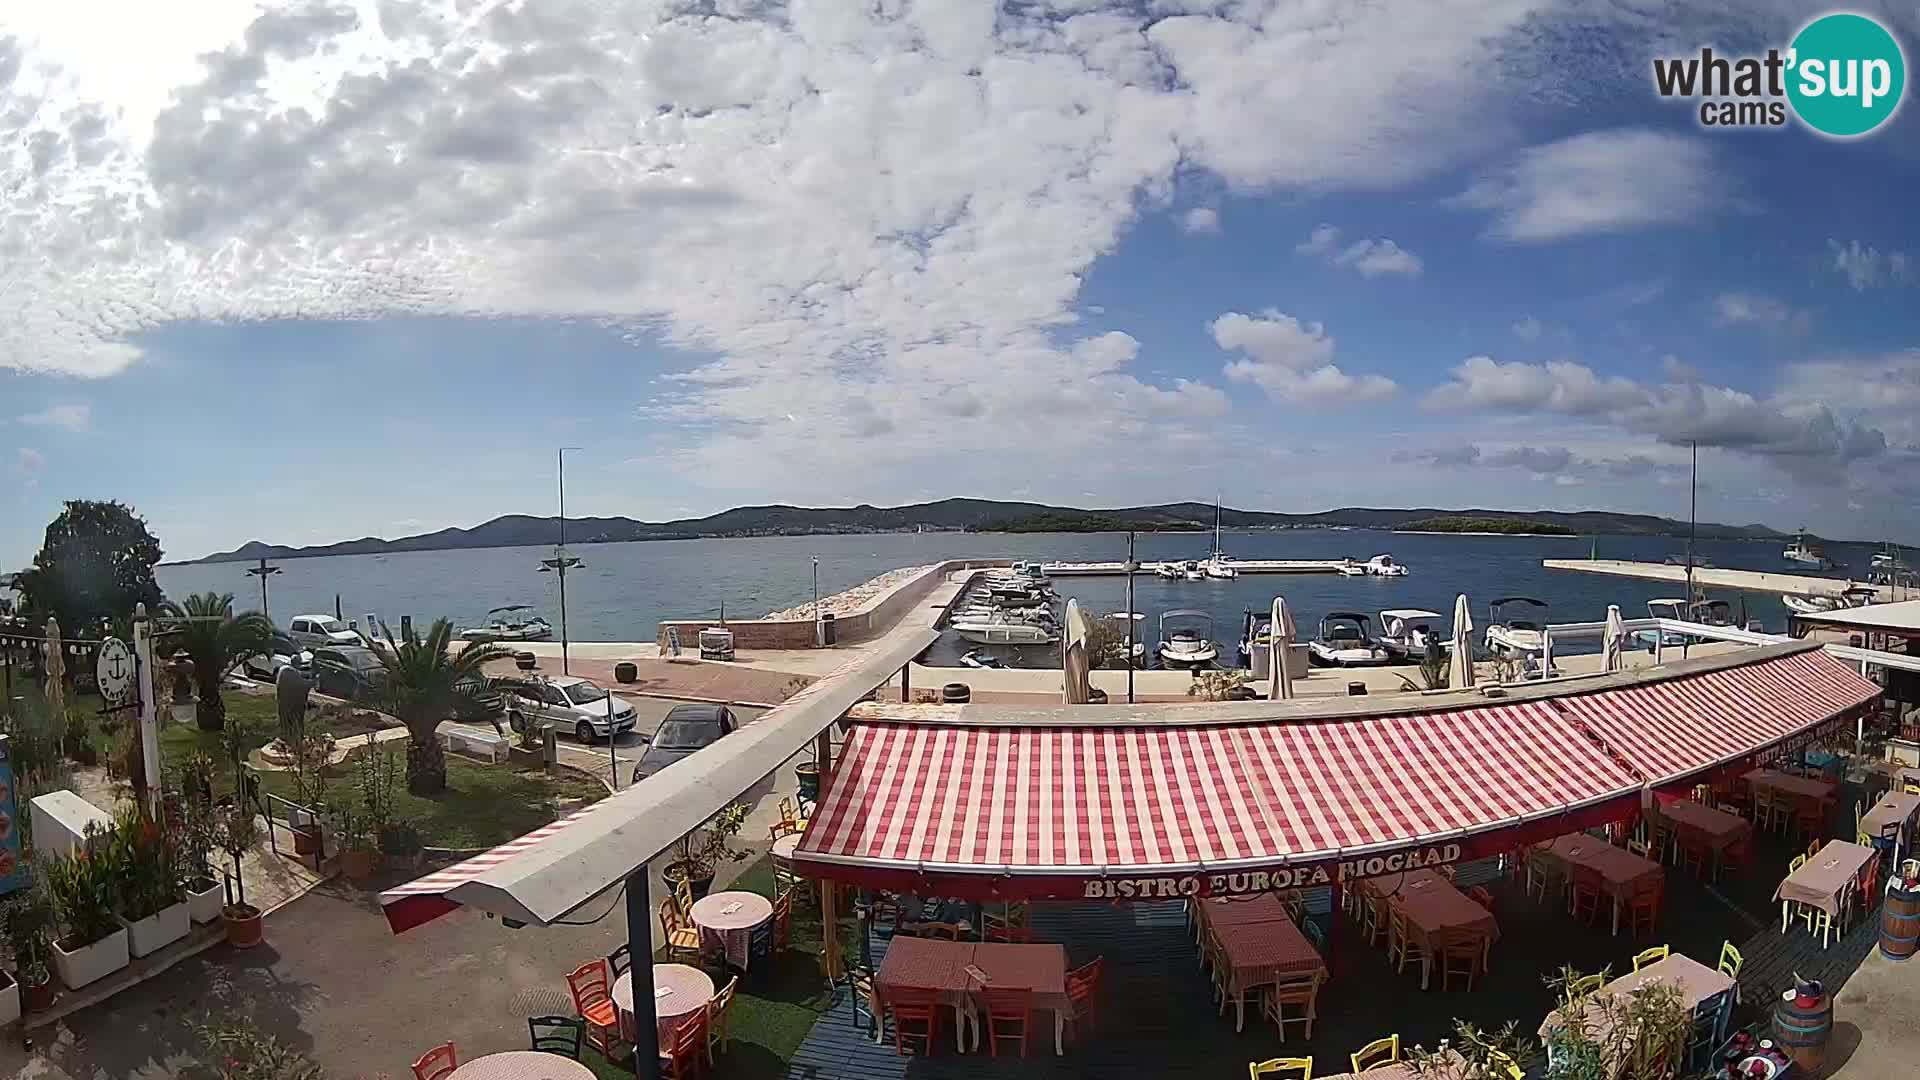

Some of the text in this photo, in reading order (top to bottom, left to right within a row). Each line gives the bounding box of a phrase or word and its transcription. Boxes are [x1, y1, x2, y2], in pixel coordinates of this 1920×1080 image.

[1083, 843, 1461, 898] BISTRO EUROPA BIOGRAD
